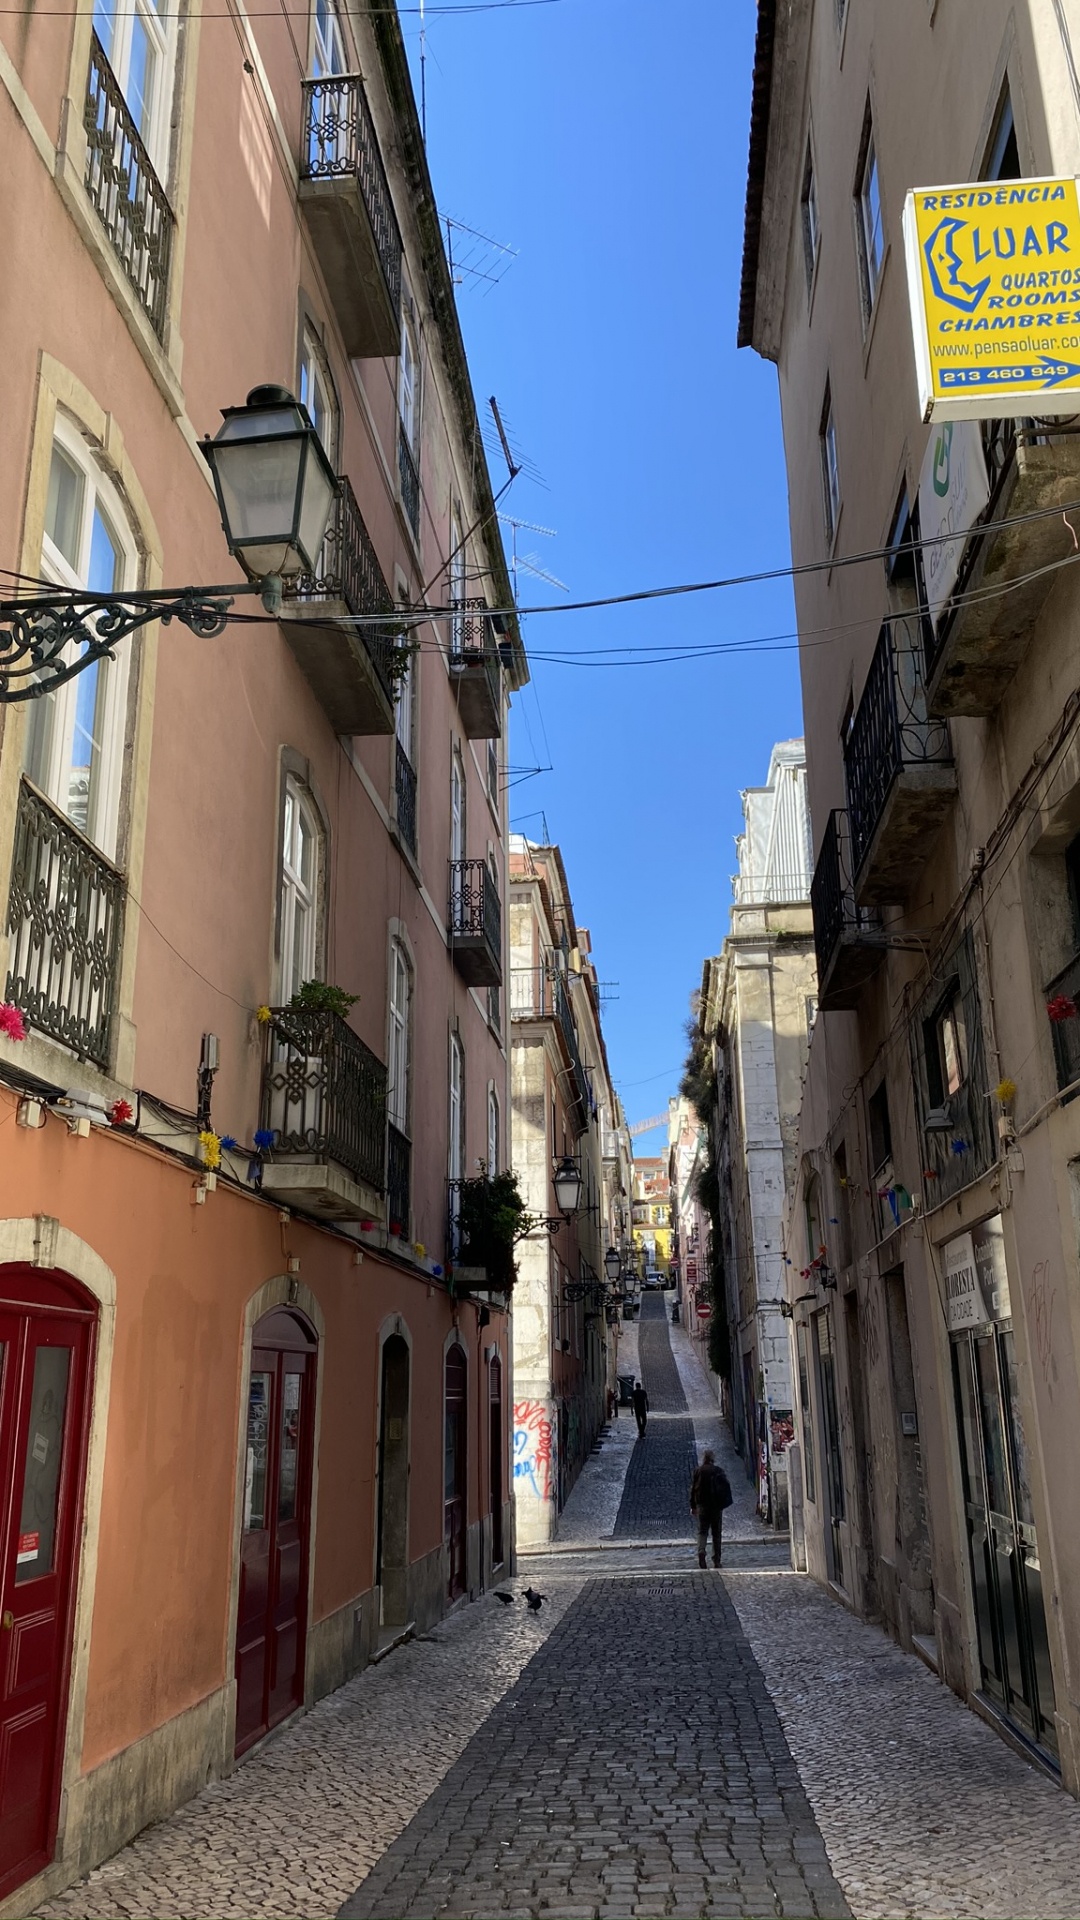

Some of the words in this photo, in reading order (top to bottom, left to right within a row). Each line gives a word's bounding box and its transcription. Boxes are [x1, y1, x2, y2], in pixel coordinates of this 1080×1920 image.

[923, 186, 1066, 211] RESIDÊNCIA
[972, 220, 1071, 264] LUAR
[1001, 267, 1080, 290] QUARTOS
[987, 288, 1080, 309] ROOMS
[939, 311, 1080, 333] CHAMBRES
[933, 335, 1080, 359] www.pensaoluar.co
[943, 371, 981, 383] 213
[986, 368, 1025, 379] 460
[1030, 365, 1069, 376] 949
